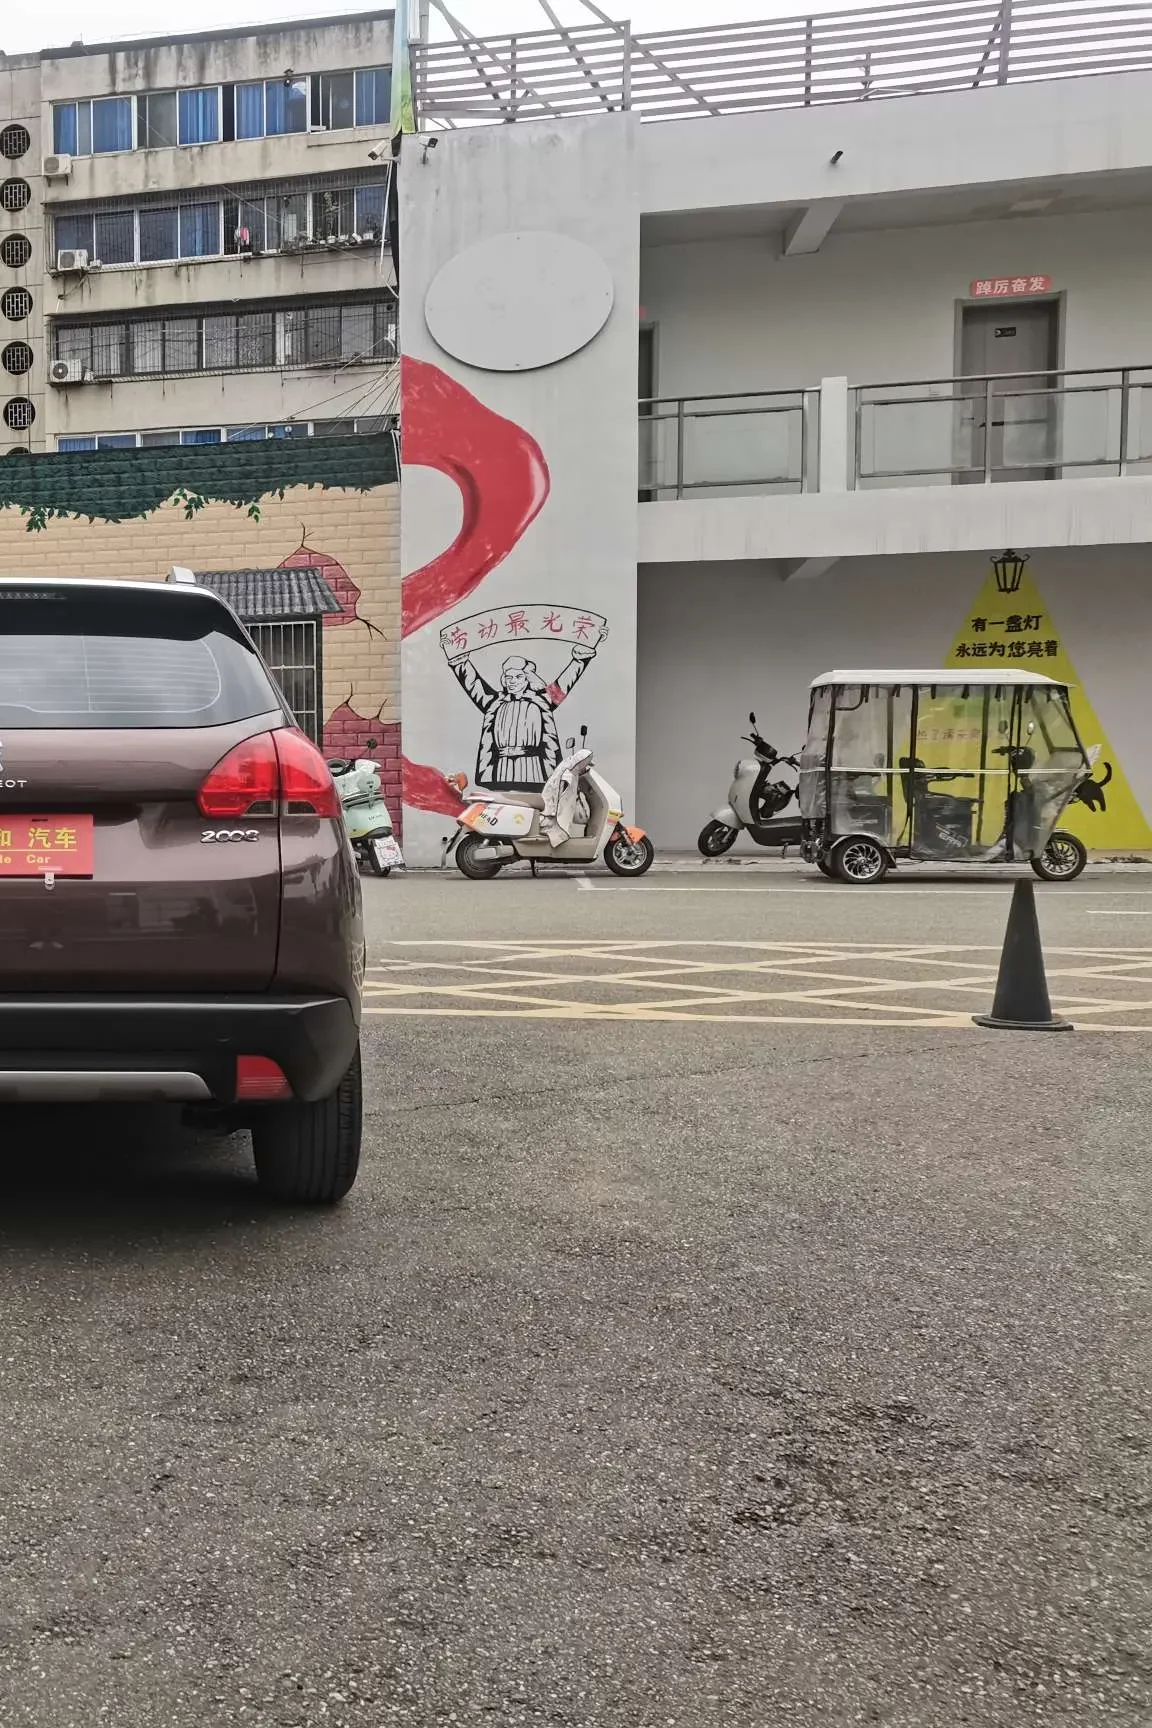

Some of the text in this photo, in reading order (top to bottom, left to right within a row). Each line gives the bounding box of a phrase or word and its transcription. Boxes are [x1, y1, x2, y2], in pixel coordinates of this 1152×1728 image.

[975, 276, 1046, 295] 踔厉奋发
[450, 610, 596, 650] 劳动最光荣
[971, 614, 1043, 633] 有一盏灯
[955, 640, 1058, 658] 永远为您亮着
[28, 827, 77, 849] 汽车
[26, 854, 51, 864] Car
